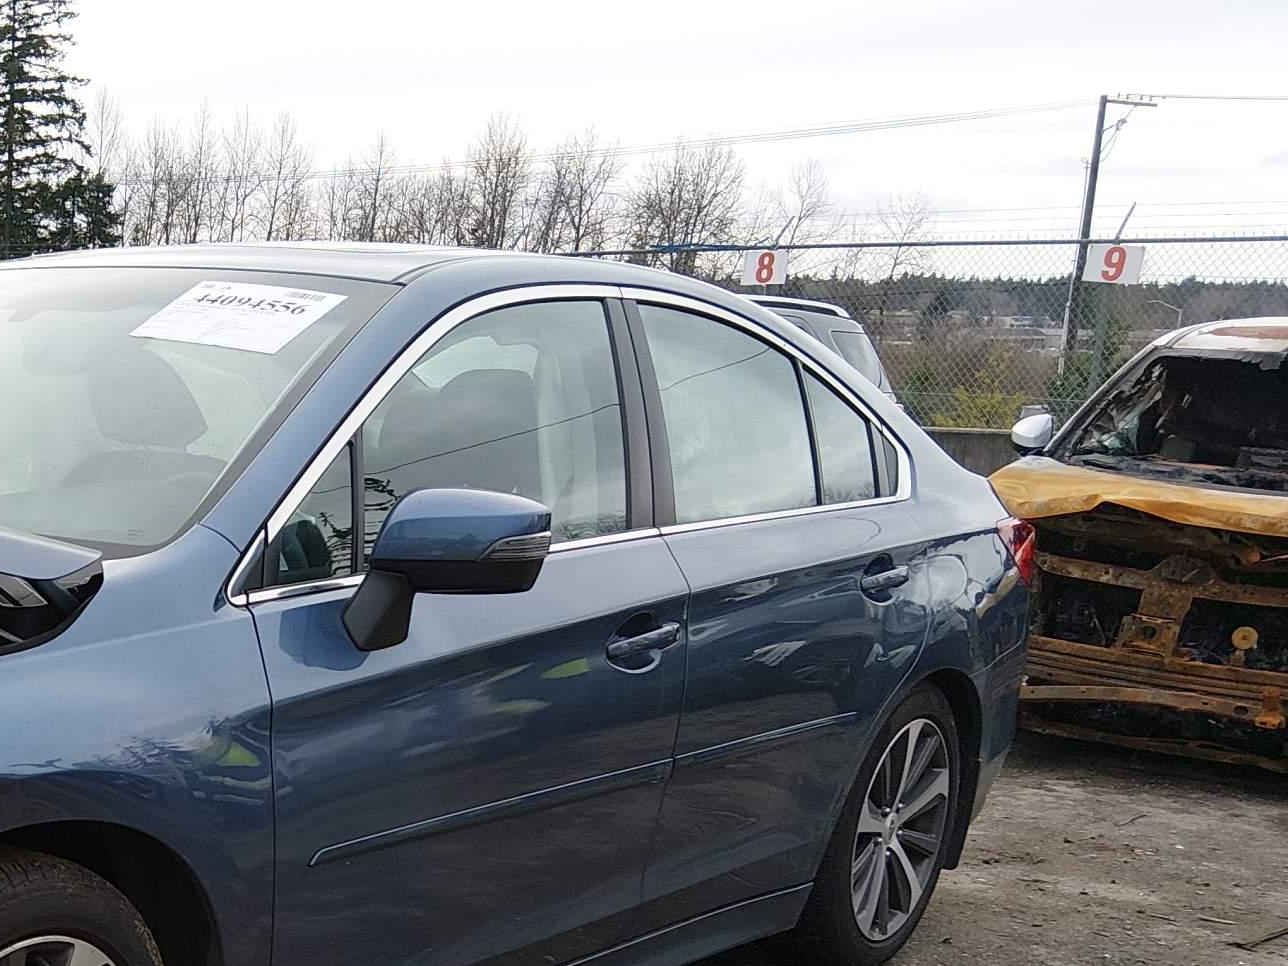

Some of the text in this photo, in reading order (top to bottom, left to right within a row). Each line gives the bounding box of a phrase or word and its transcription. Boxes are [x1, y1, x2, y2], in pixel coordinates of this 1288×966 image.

[755, 252, 775, 283] 8
[1101, 246, 1127, 282] 9
[194, 292, 308, 316] 44094556
